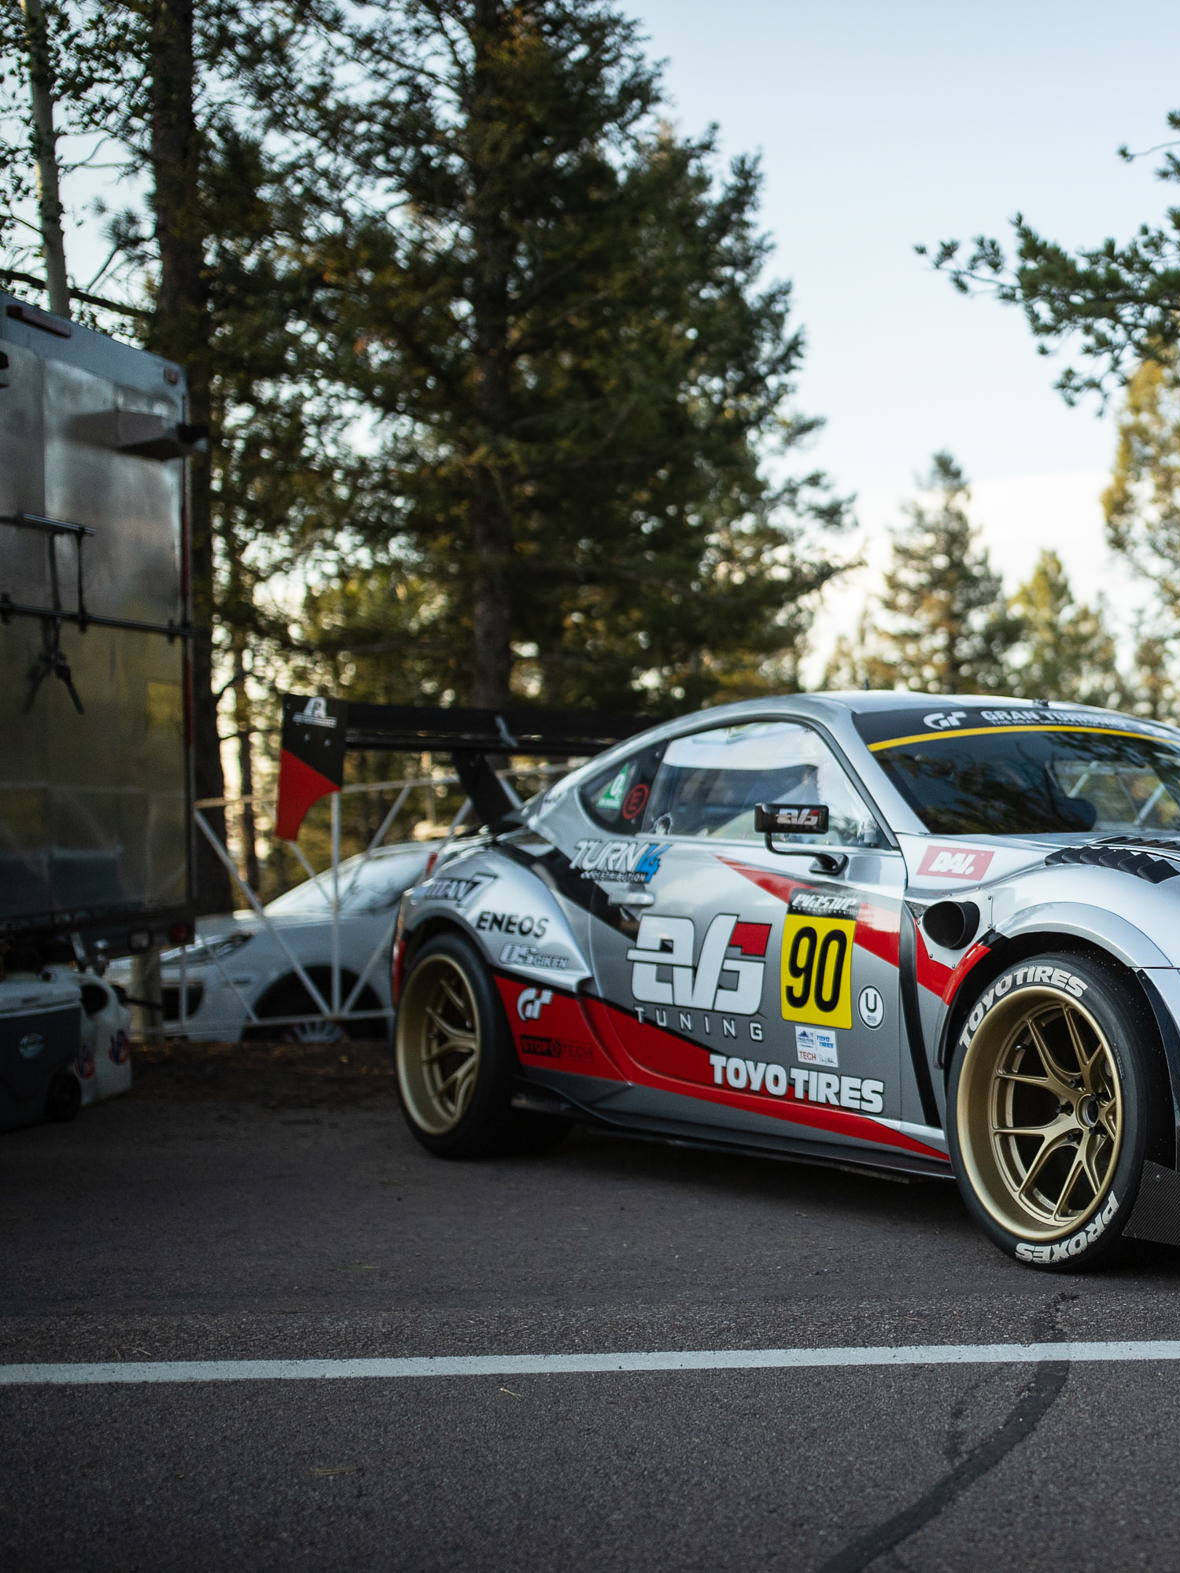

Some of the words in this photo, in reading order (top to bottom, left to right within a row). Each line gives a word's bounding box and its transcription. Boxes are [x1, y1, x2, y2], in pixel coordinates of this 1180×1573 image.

[980, 710, 1041, 721] GRAN
[476, 911, 549, 939] ENEOS
[786, 926, 847, 1012] 90
[634, 1007, 764, 1041] TUNING
[959, 976, 1013, 1049] TOYO
[1014, 966, 1088, 998] TIRES
[799, 1051, 817, 1061] TECH
[709, 1053, 788, 1097] TOYO
[790, 1067, 885, 1114] TIRES
[1015, 1190, 1120, 1264] PROXES
